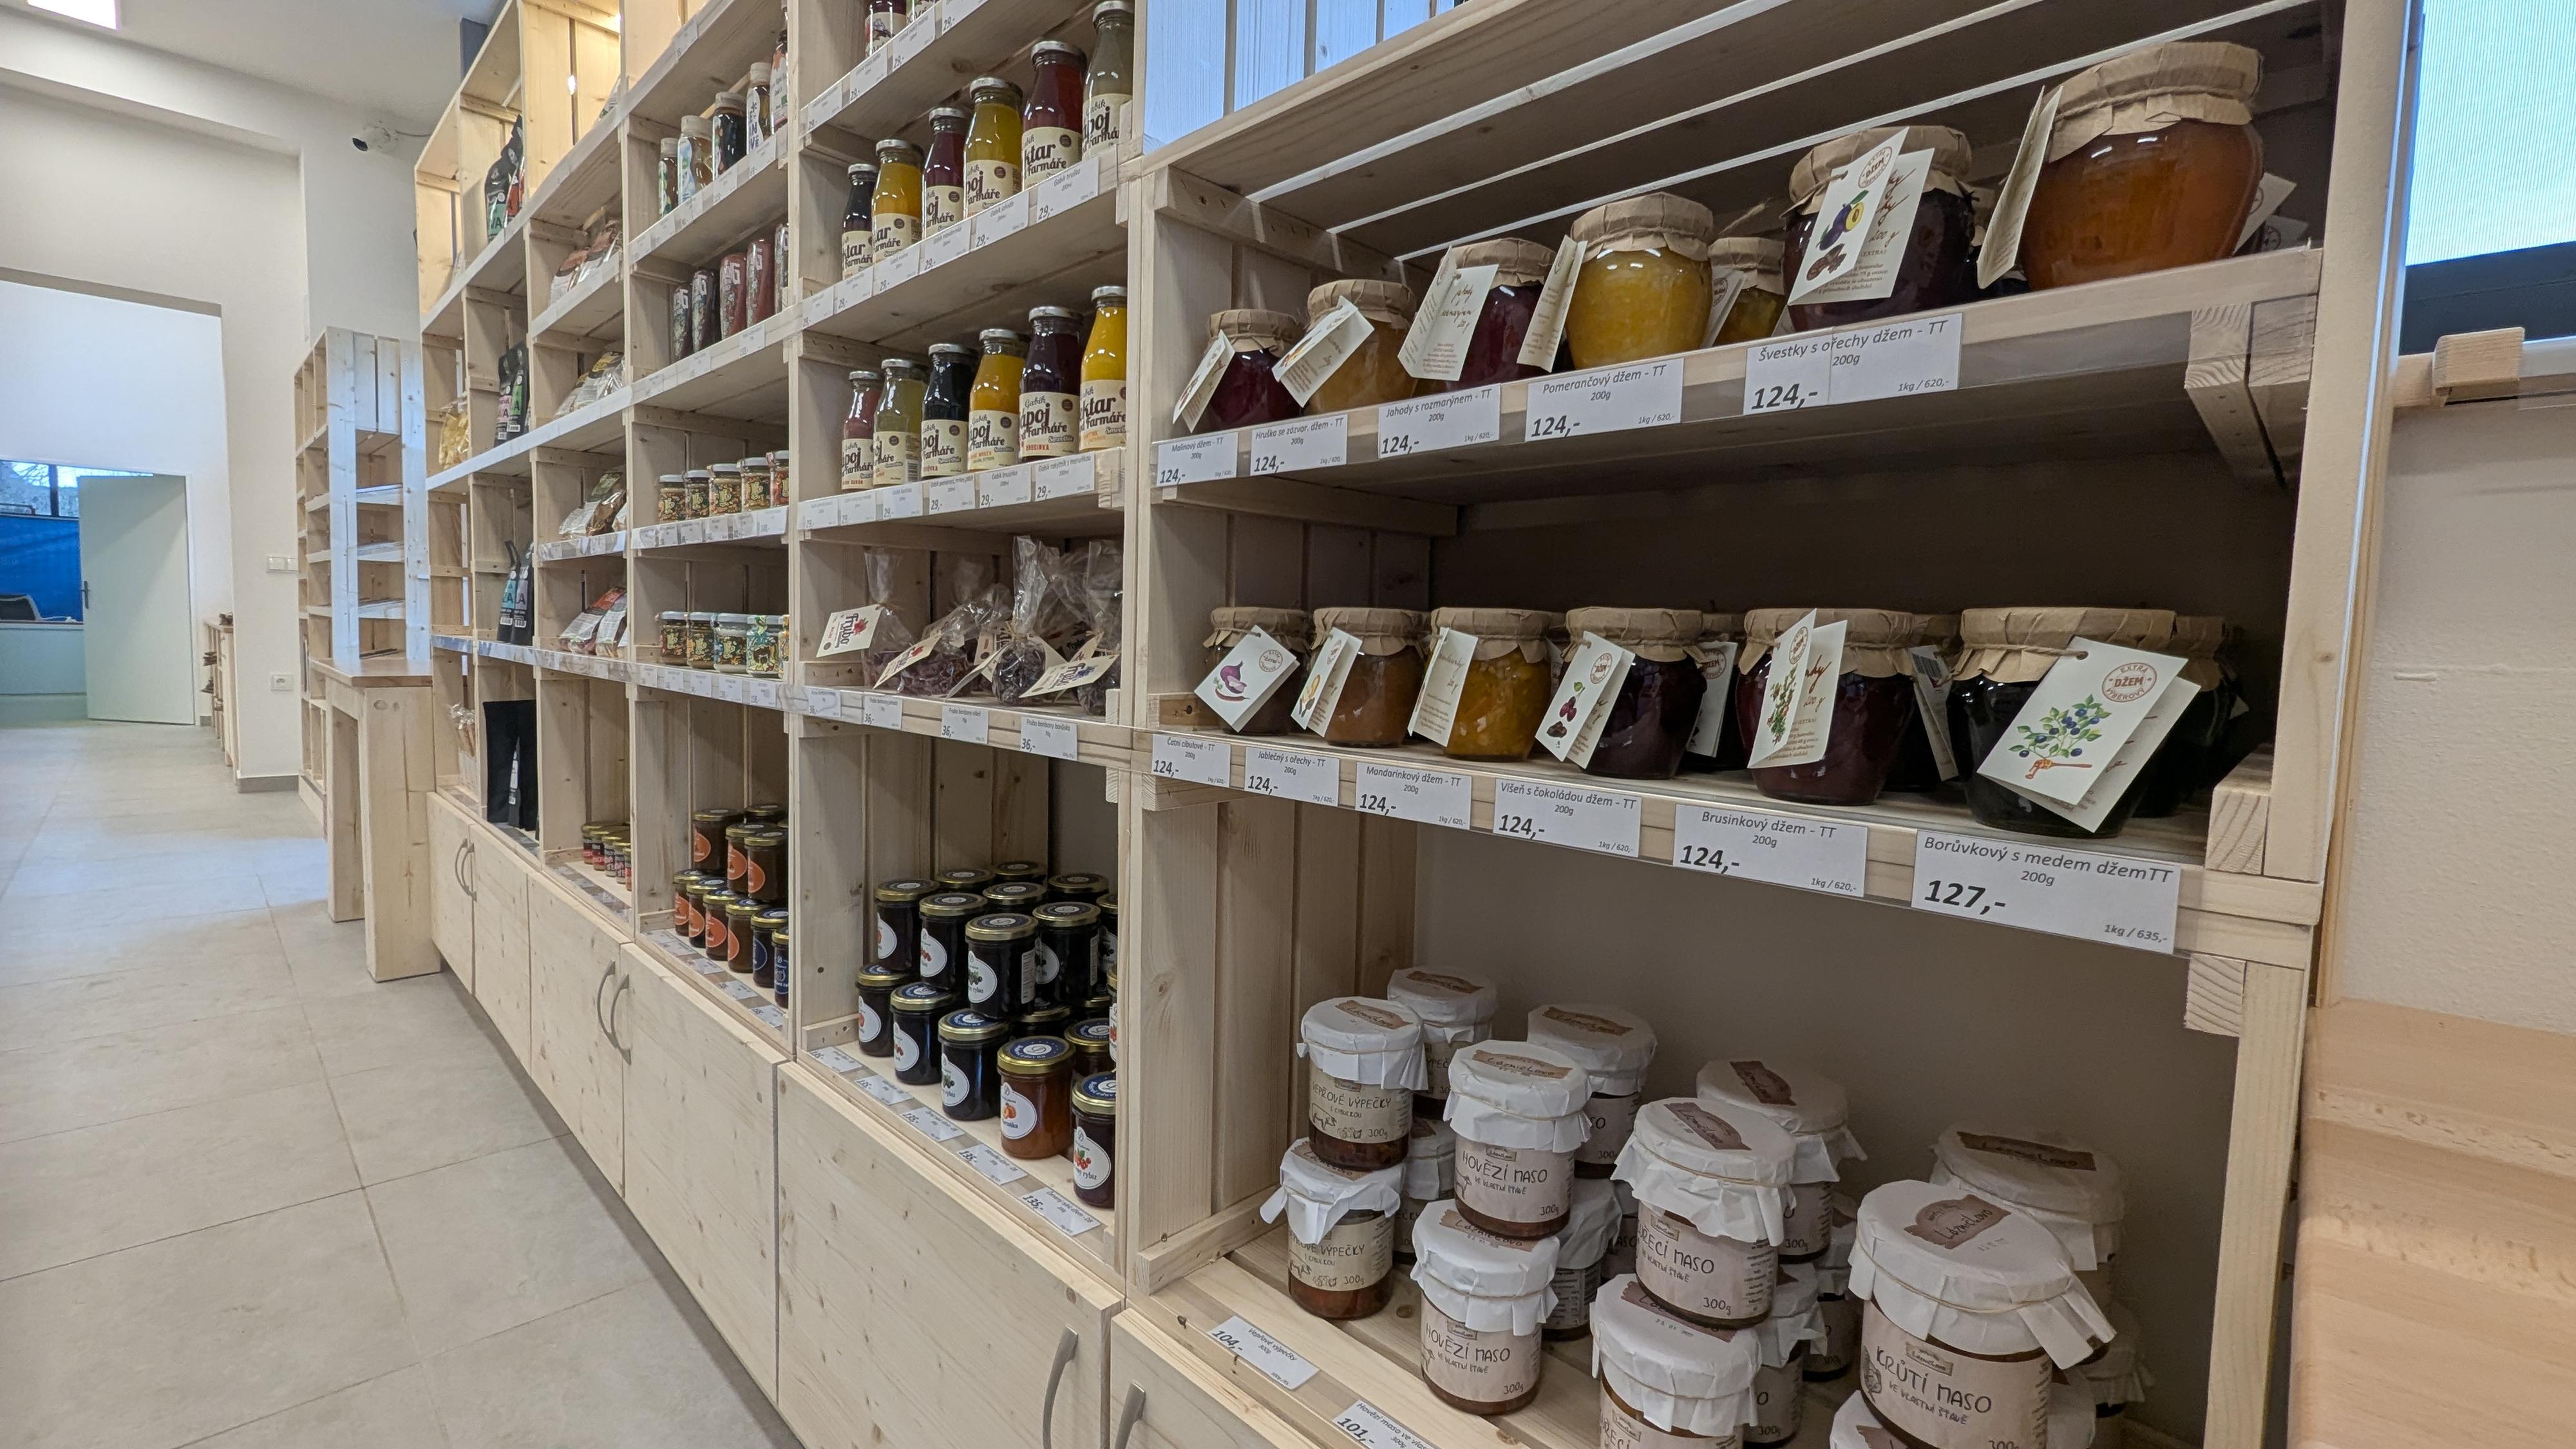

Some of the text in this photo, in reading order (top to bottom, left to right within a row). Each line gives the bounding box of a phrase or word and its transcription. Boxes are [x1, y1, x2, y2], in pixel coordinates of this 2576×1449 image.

[1025, 142, 1056, 166] ktar
[967, 187, 1001, 205] armáře
[1037, 205, 1054, 220] 29,-
[1758, 344, 1808, 362] Švestky
[1810, 343, 1817, 353] s
[1821, 334, 1869, 352] ořechy
[1873, 327, 1912, 344] džem
[1929, 320, 1949, 334] TT
[1832, 354, 1860, 366] 200g
[1543, 365, 1667, 395] Pomerančový džem TT
[1898, 382, 1915, 393] 1kg
[1924, 377, 1949, 388] 620,-
[1386, 388, 1493, 419] Jahody s rozmarýnem TT
[1590, 390, 1611, 402] 200g
[1751, 383, 1819, 409] 124,-
[1021, 403, 1051, 428] ápoj
[1083, 397, 1117, 417] ktar
[1428, 412, 1444, 423] 200g
[1531, 415, 1580, 438] 124,-
[1638, 415, 1651, 425] 1kg
[1027, 422, 1067, 438] farmáře
[1255, 428, 1277, 440] Hruška
[1311, 421, 1329, 431] džem
[1335, 417, 1345, 427] TT
[1291, 437, 1303, 446] 200g
[1381, 435, 1420, 455] 124,-
[1254, 455, 1285, 473] 124,-
[1159, 468, 1186, 484] 124,-
[981, 494, 994, 507] 29,-
[1037, 485, 1052, 500] 29,-
[2120, 665, 2148, 674] EXTRA
[2114, 676, 2144, 688] DŽEM
[942, 725, 954, 738] 36,-
[1021, 738, 1036, 752] 36,-
[1153, 760, 1179, 776] 124,-
[1257, 750, 1285, 764] Jablečný
[1290, 752, 1312, 768] ořechy
[1317, 759, 1326, 768] TT
[1284, 765, 1297, 775] 200g
[1366, 766, 1461, 787] Mandarinkový džem TT
[1247, 775, 1278, 795] 124,-
[1403, 784, 1419, 794] 200g
[1359, 793, 1397, 815] 124,-
[1501, 781, 1524, 796] Višeň
[1533, 786, 1584, 803] čokoládou
[1586, 791, 1613, 807] džem
[1623, 799, 1637, 810] TT
[1554, 804, 1574, 816] 200g
[1499, 813, 1546, 839] 124,-
[1701, 810, 1837, 838] Brusinkový džem TT
[1752, 834, 1777, 848] 200g
[1679, 844, 1740, 875] 124,-
[1924, 836, 2007, 862] Borůvkový
[2011, 851, 2020, 861] s
[2025, 851, 2091, 872] medem
[1811, 876, 1857, 893] 1kg 620,-
[2020, 870, 2055, 887] 200g
[1924, 880, 2007, 915] 127,-
[2105, 923, 2125, 936] 1kg
[2137, 929, 2168, 943] 635,-
[1349, 1097, 1392, 1110] VÝPEČKY
[1368, 1128, 1388, 1139] 300g
[1463, 1150, 1548, 1183] HOVĚZÍ MASO
[1023, 1195, 1044, 1211] 135,-
[1540, 1204, 1560, 1217] 300g
[1321, 1244, 1365, 1256] VÝPEČKY
[1674, 1248, 1715, 1274] MASO
[1344, 1275, 1365, 1286] 300g
[1703, 1296, 1732, 1316] 300g
[1212, 1330, 1244, 1352] 104,-
[1426, 1321, 1511, 1362] HOVĚZÍ MASO
[1503, 1381, 1524, 1395] 300g
[1877, 1345, 1929, 1394] KRŮTÍ
[1937, 1383, 1992, 1414] MASO
[1356, 1402, 1382, 1422] Hovězí
[1381, 1416, 1401, 1435] maso
[1338, 1417, 1376, 1445] 101,-
